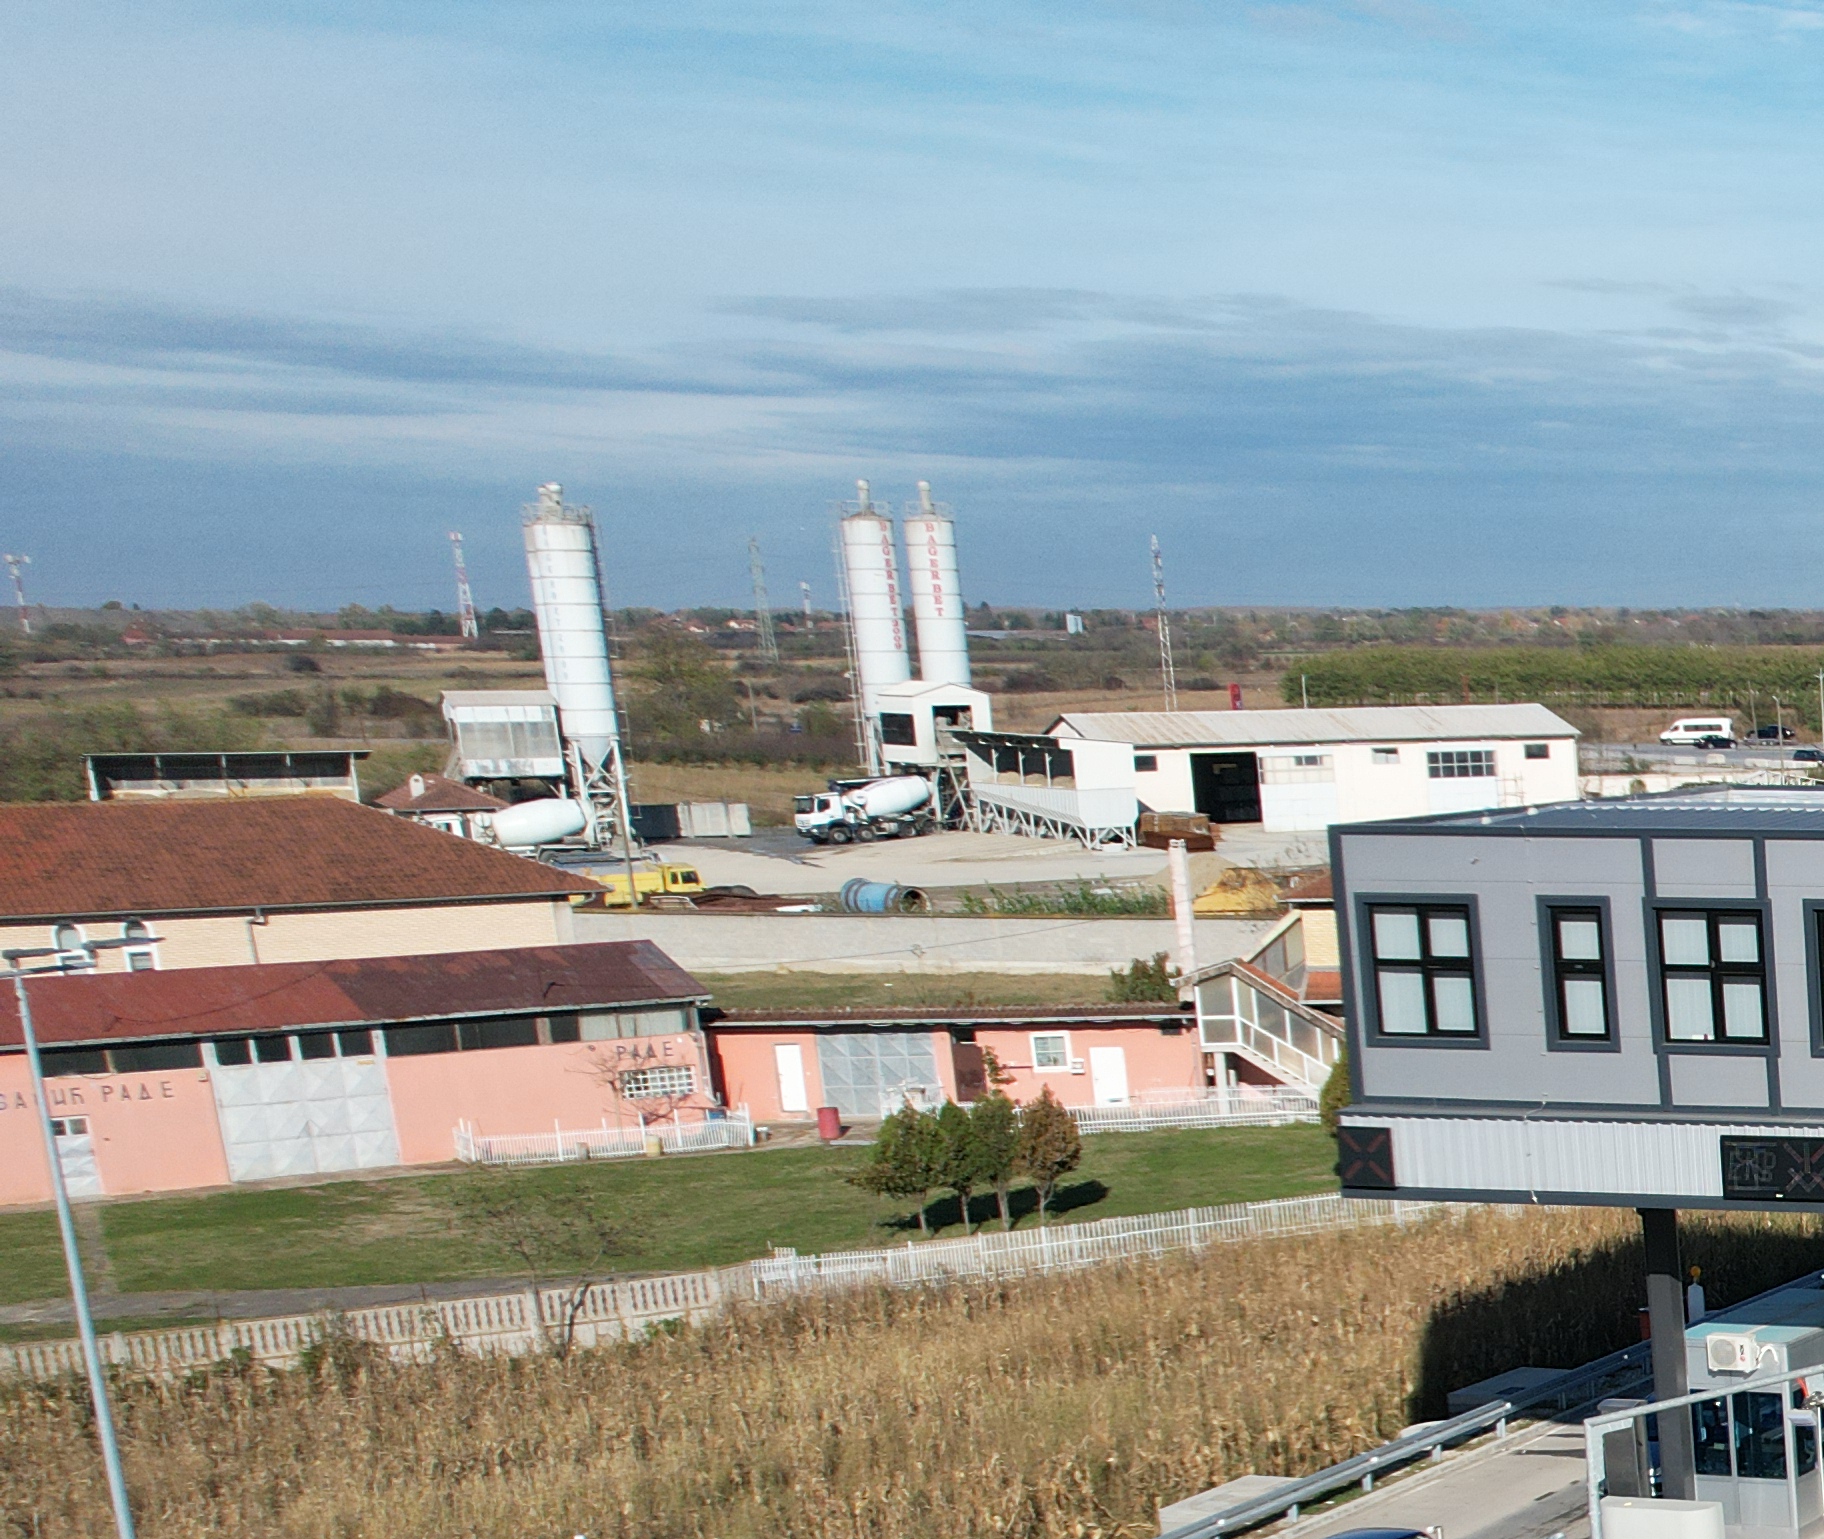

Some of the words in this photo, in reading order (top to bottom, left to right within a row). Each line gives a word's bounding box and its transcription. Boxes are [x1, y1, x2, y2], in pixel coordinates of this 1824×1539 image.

[925, 521, 944, 617] BAGERBET
[615, 1040, 674, 1061] РАДЕ
[101, 1081, 175, 1103] РАДЕ
